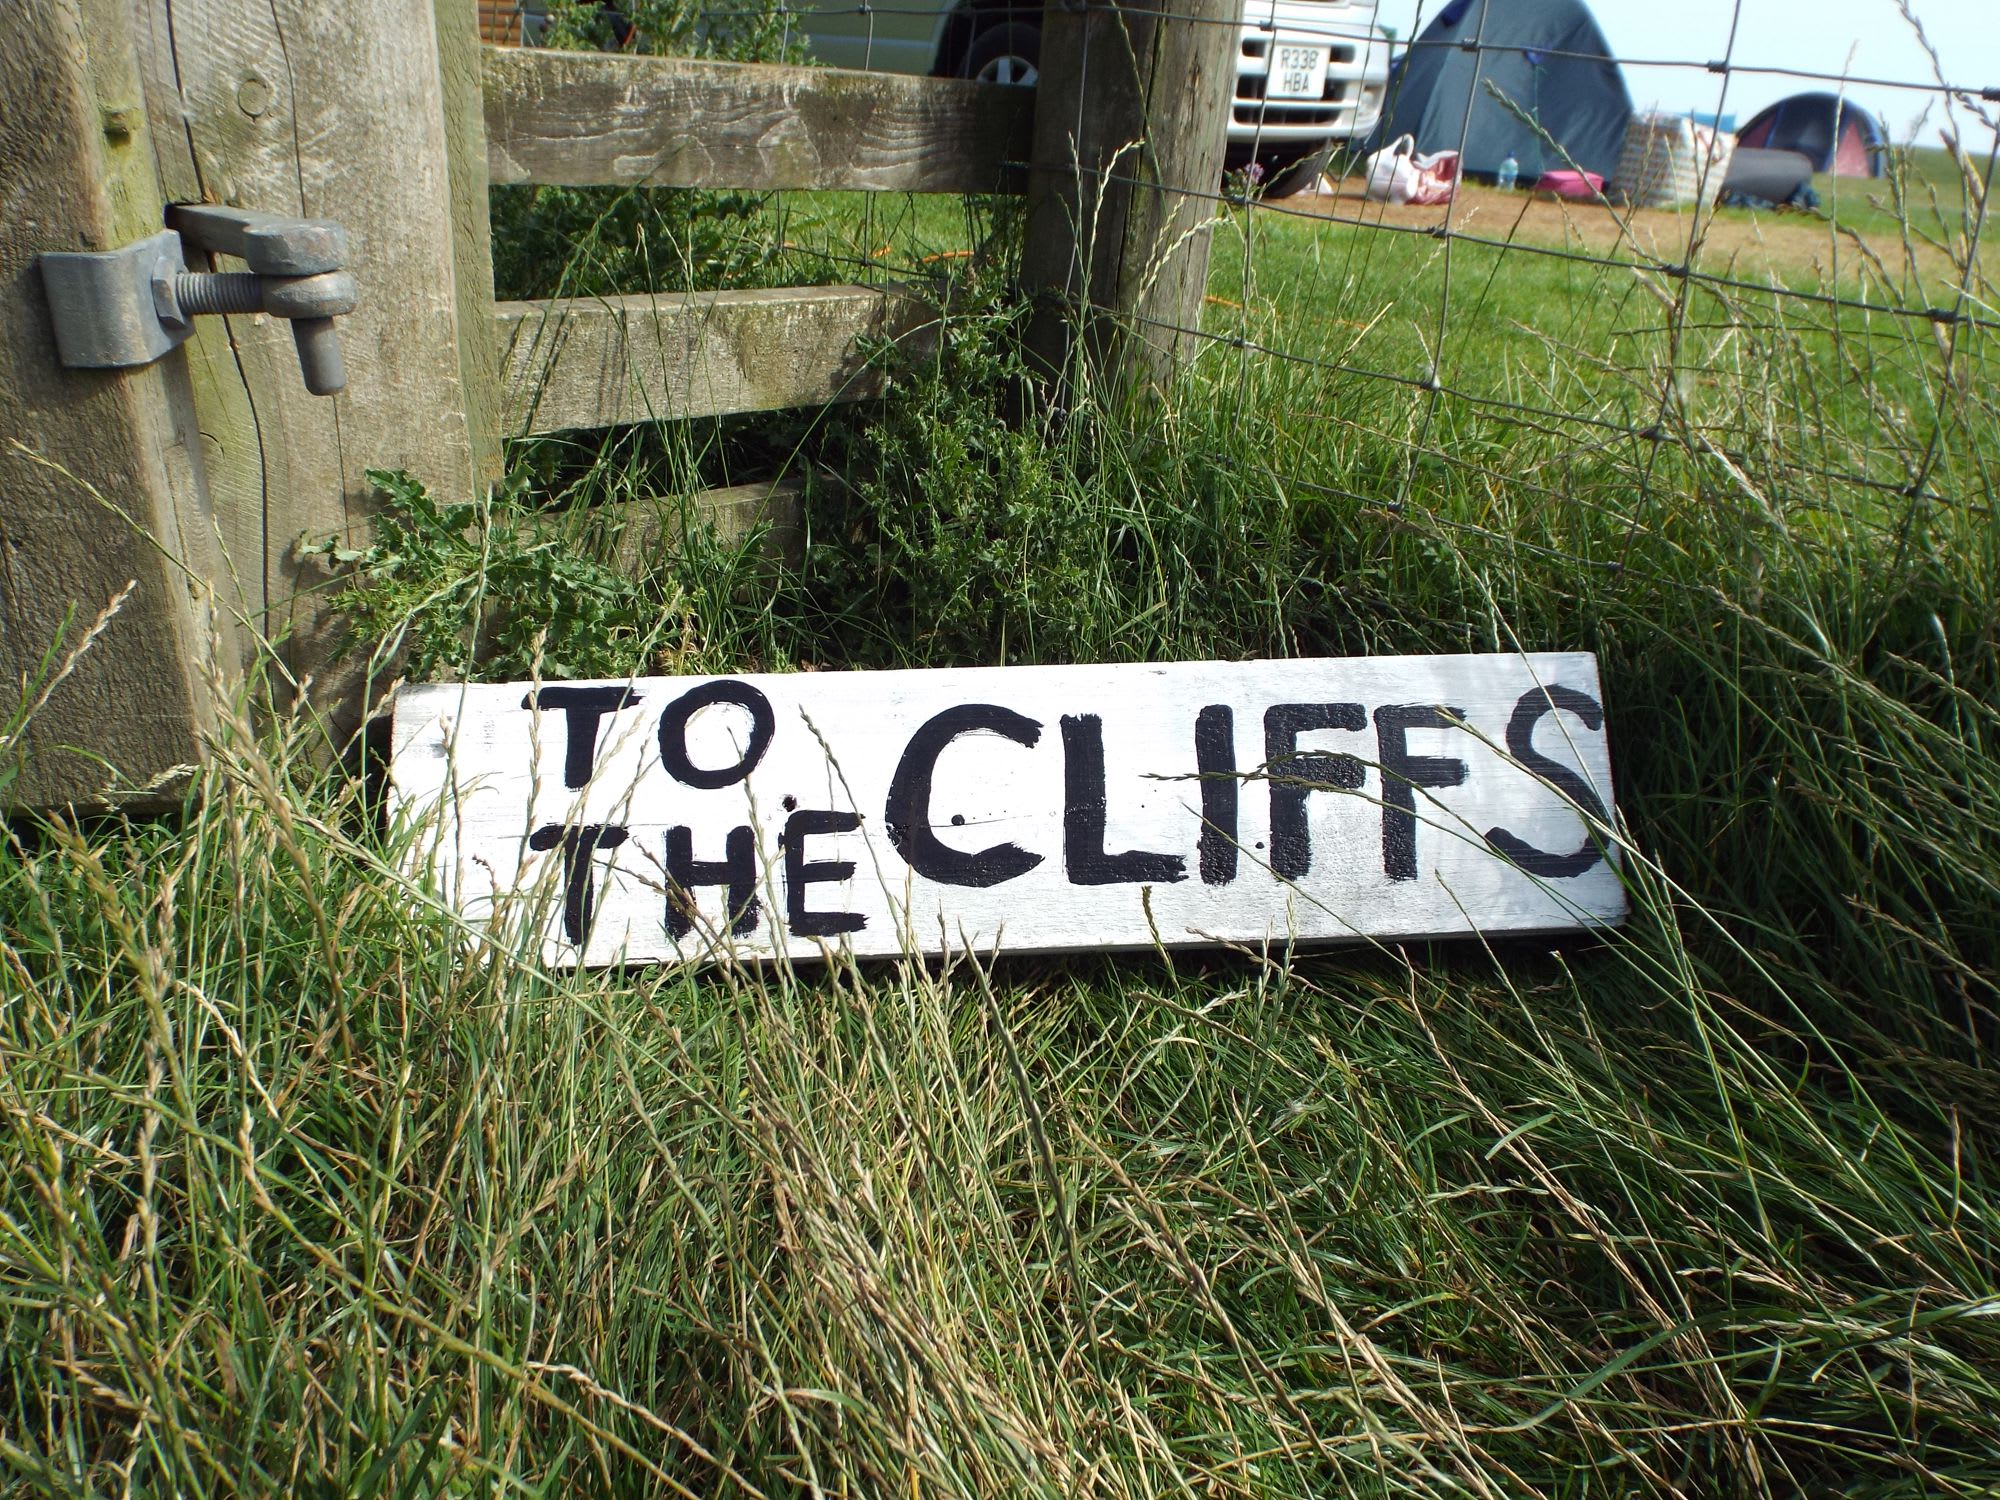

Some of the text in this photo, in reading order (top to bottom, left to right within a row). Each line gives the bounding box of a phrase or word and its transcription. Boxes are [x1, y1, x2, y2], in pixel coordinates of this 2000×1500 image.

[1280, 48, 1319, 70] R338
[1282, 72, 1310, 93] HBA
[521, 679, 776, 792] TO
[885, 683, 1610, 888] CLIFFS
[529, 809, 871, 946] THE
